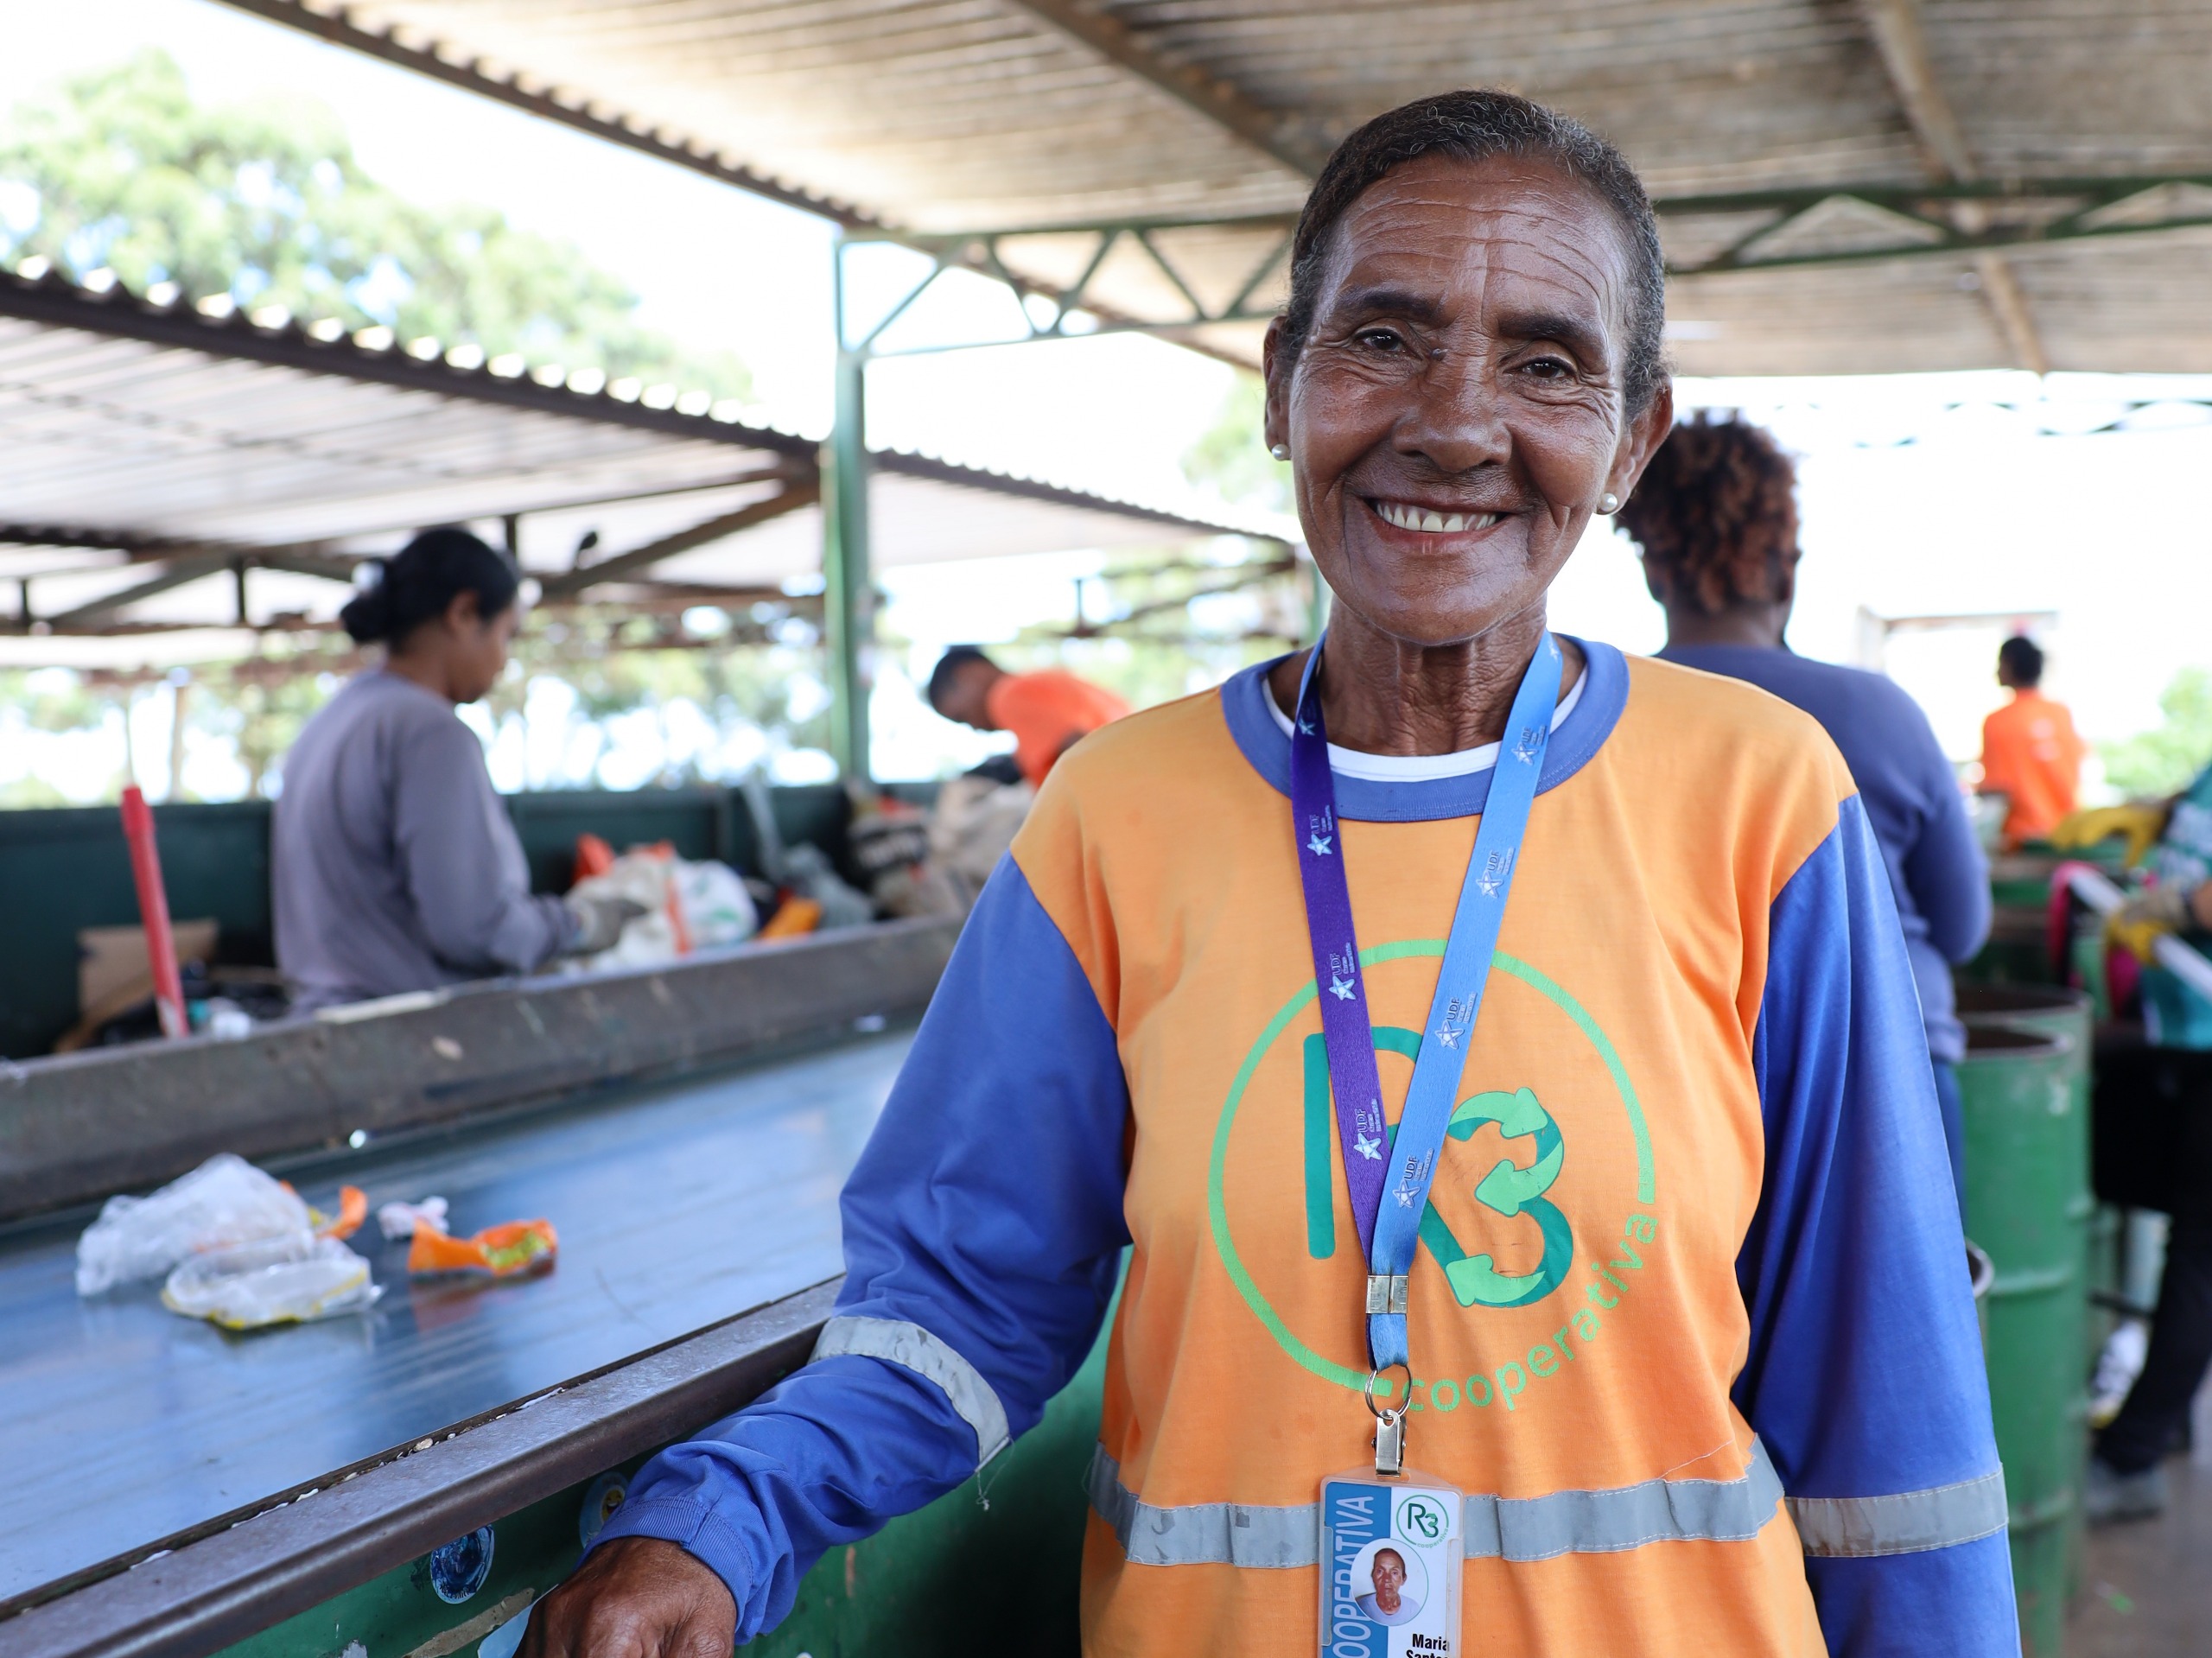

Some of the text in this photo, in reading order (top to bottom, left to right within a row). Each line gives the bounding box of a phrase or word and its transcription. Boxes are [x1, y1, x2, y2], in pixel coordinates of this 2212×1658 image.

[1486, 850, 1500, 872] UDF
[1329, 953, 1342, 975] UDF
[1446, 997, 1460, 1020] UDF
[1355, 1109, 1368, 1133] UDF
[1403, 1155, 1417, 1180] UDF
[1402, 1214, 1659, 1413] cooperativa
[1408, 1502, 1440, 1539] R3
[1412, 1633, 1450, 1652] Maria
